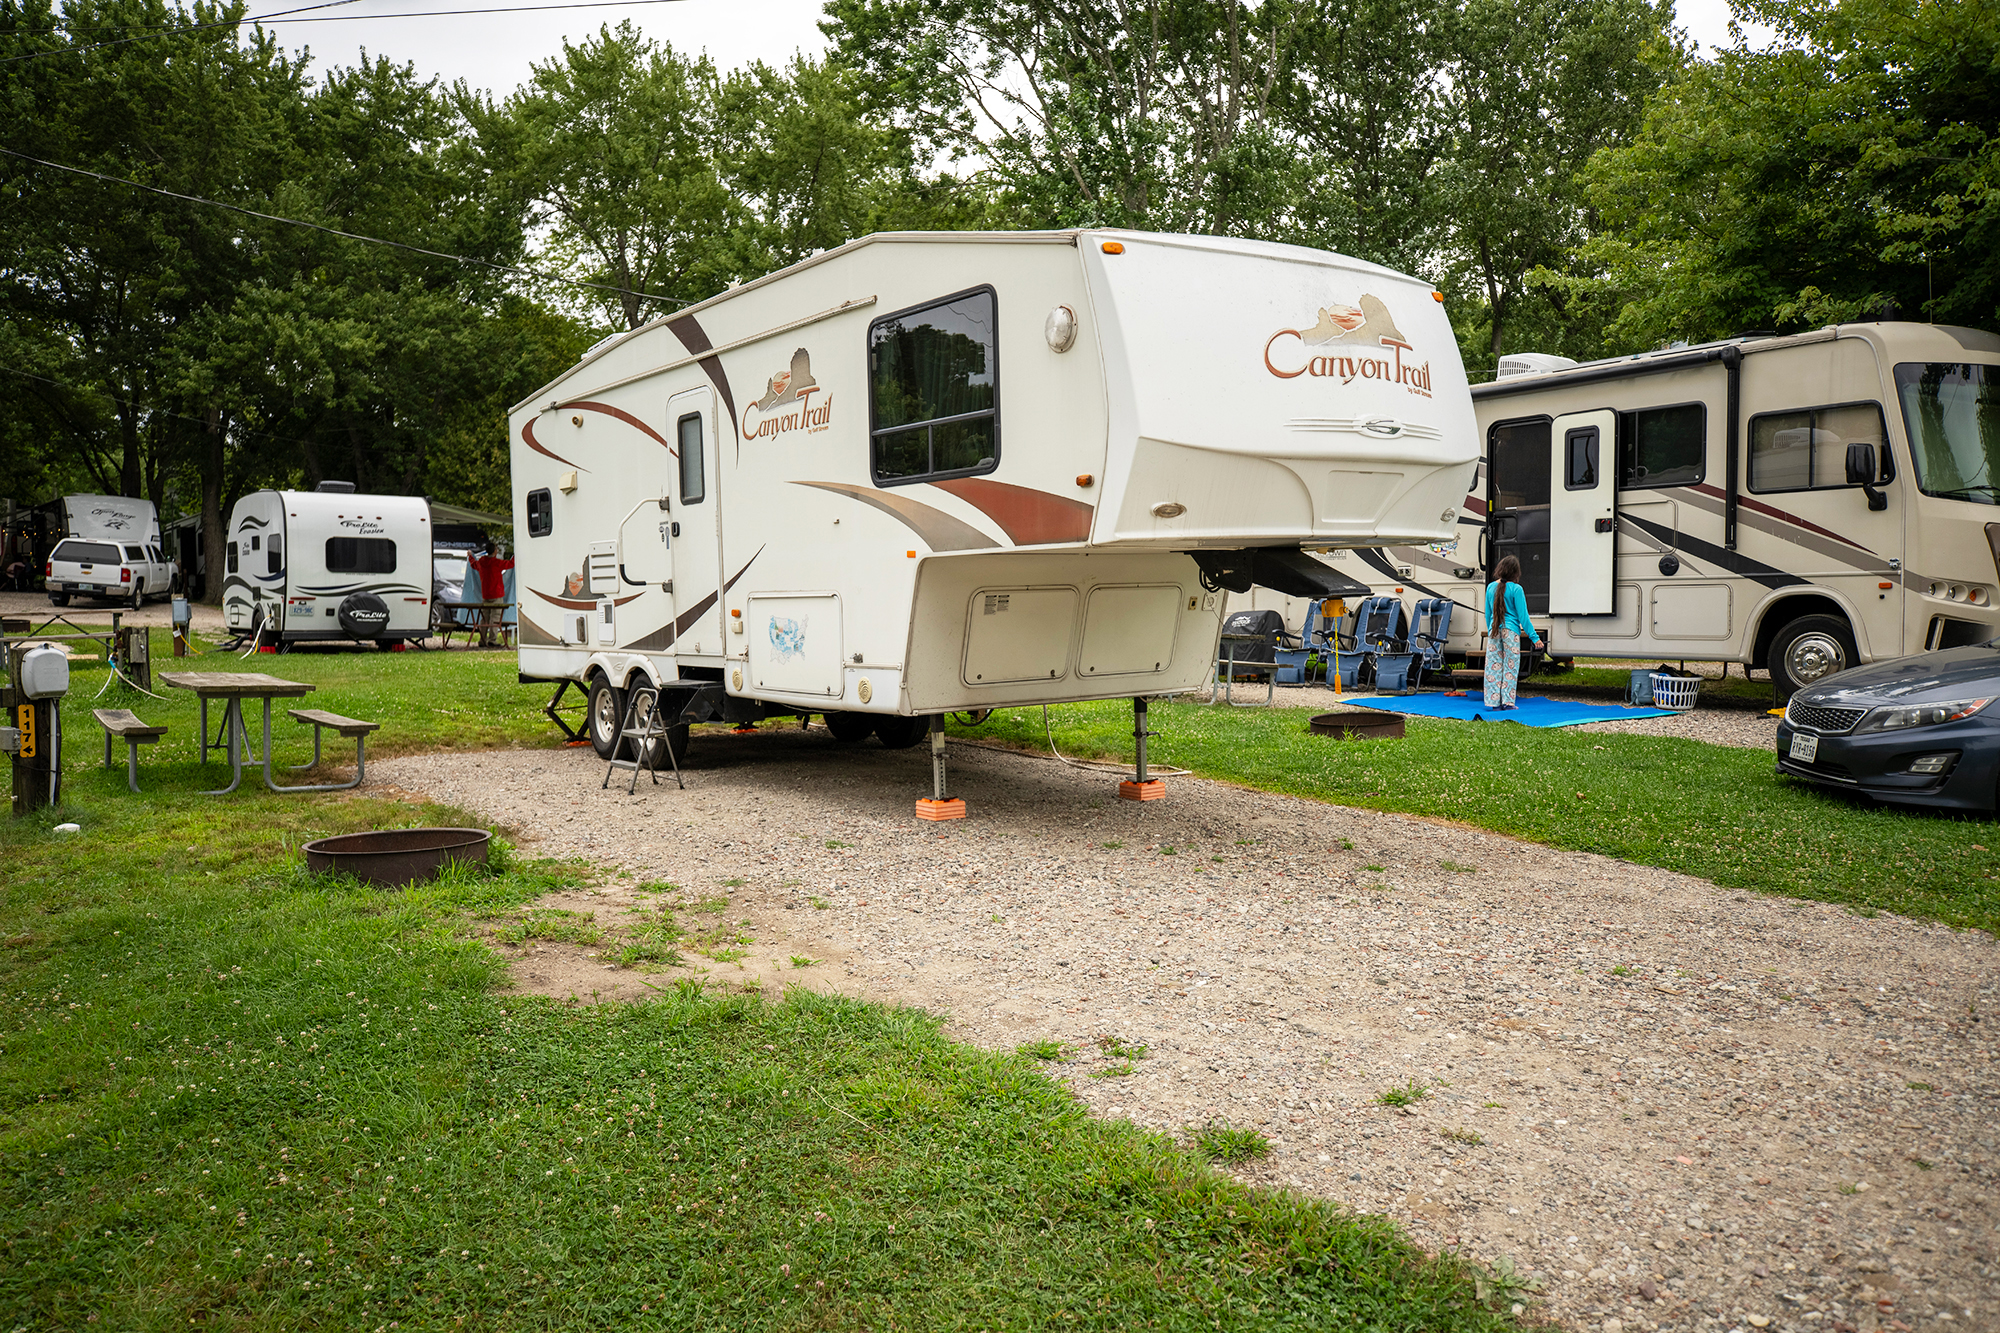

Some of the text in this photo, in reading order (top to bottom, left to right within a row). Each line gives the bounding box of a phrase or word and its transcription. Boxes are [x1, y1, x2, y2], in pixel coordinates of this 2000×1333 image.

[1264, 328, 1432, 392] Canyon Trail
[742, 386, 833, 442] Canyon Trail
[350, 609, 388, 618] ProLite
[22, 708, 32, 743] 117
